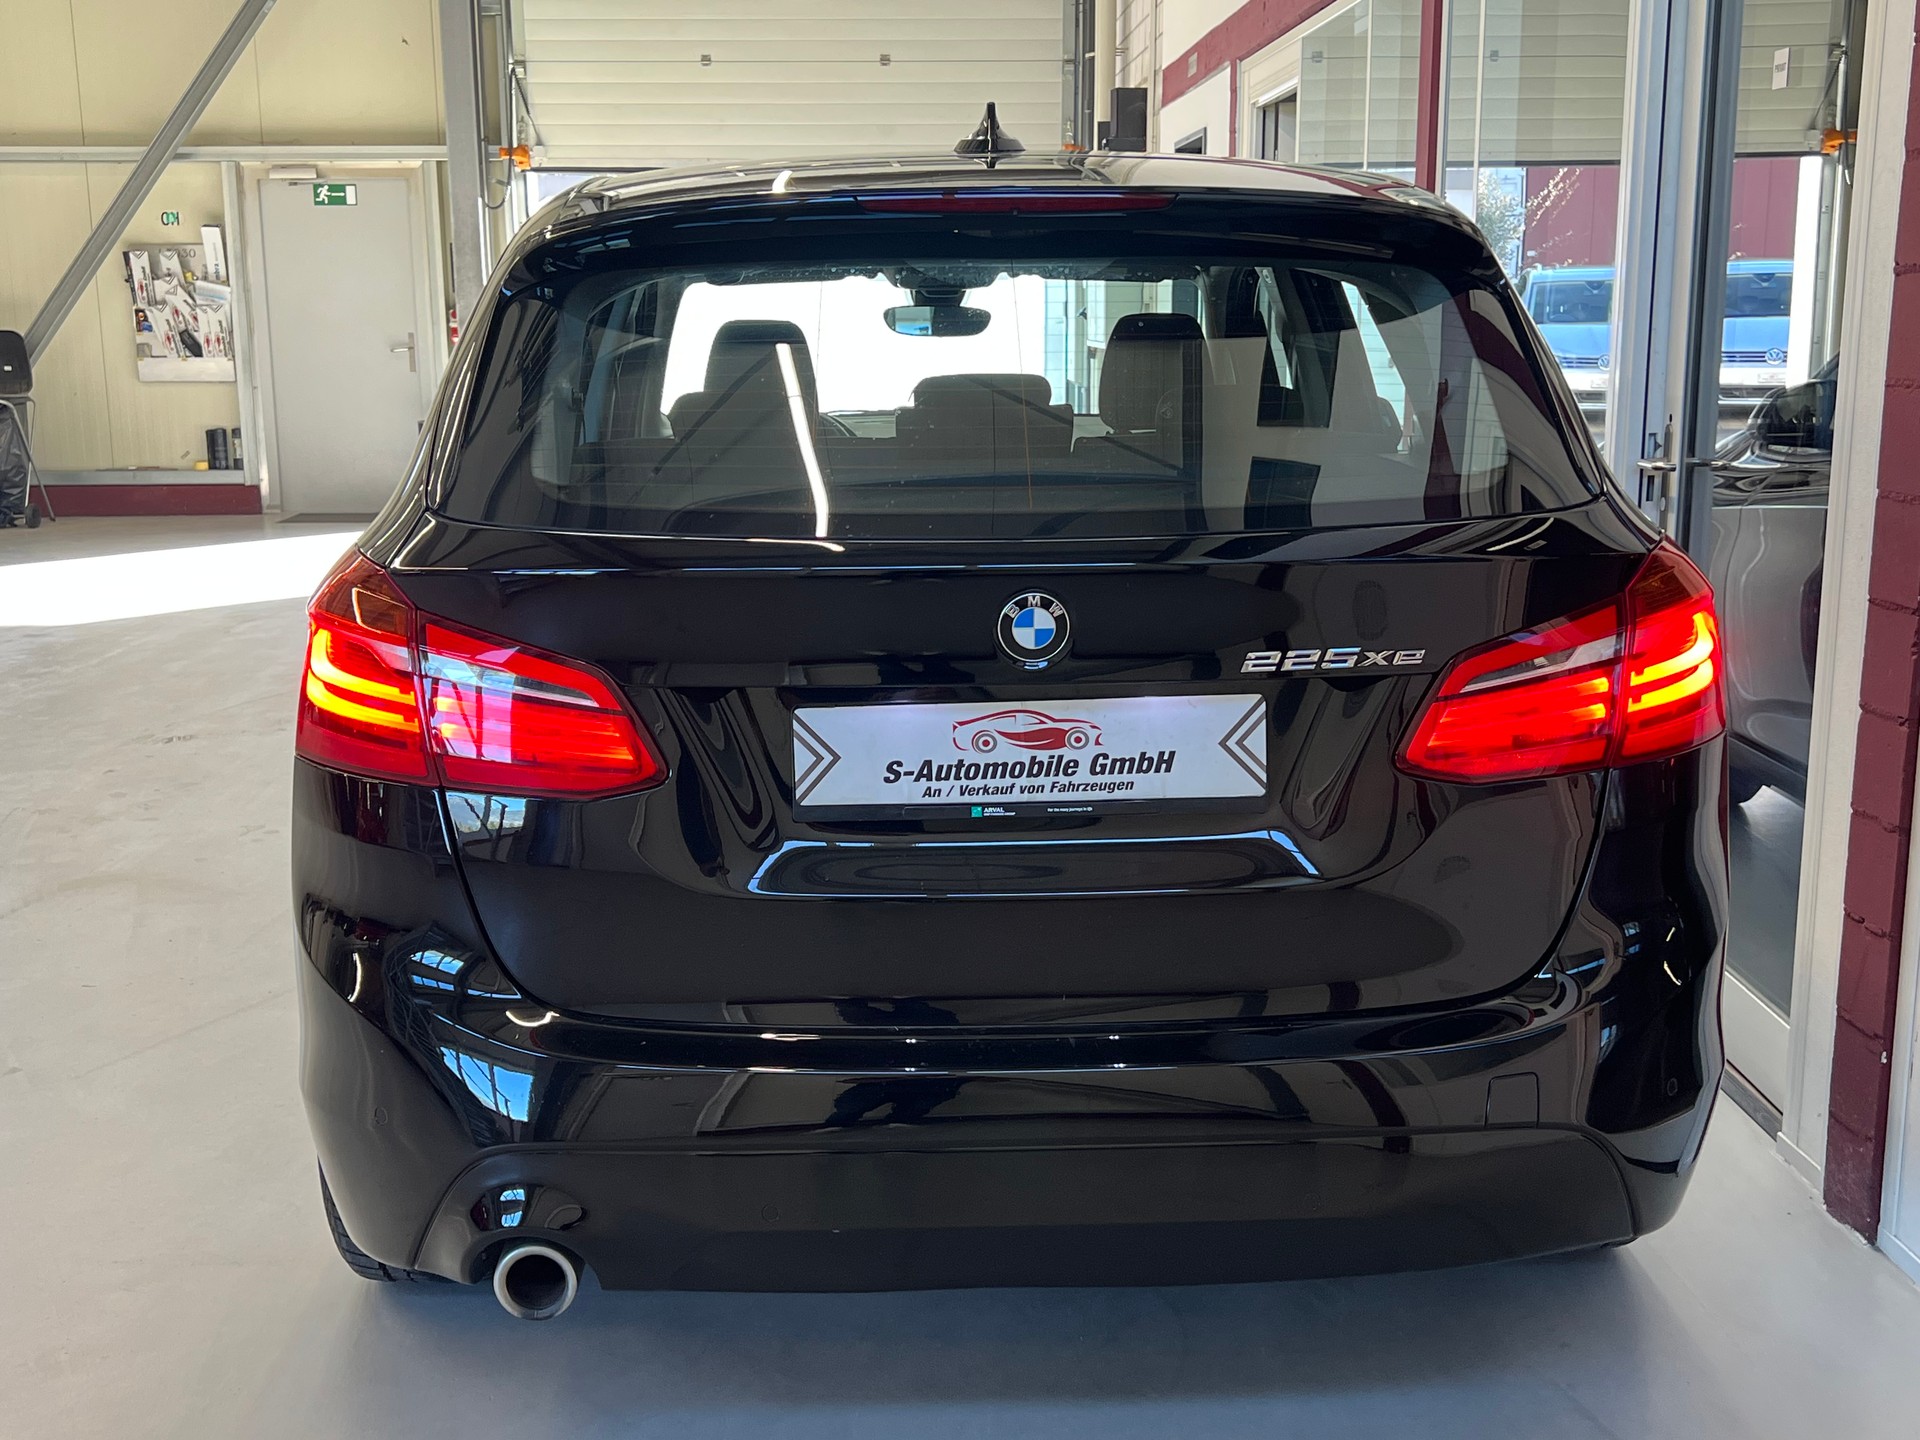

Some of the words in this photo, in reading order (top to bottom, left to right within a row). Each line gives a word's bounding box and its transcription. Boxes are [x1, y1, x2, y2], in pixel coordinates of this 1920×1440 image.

[1005, 595, 1063, 618] BMW
[1240, 647, 1425, 673] 225xe
[883, 754, 1080, 784] S-Automobile
[1089, 750, 1176, 776] GmbH
[921, 786, 942, 798] An
[946, 785, 955, 797] /
[959, 783, 1017, 796] Verkauf
[1019, 784, 1045, 795] von
[1050, 780, 1135, 794] Fahrzeugen
